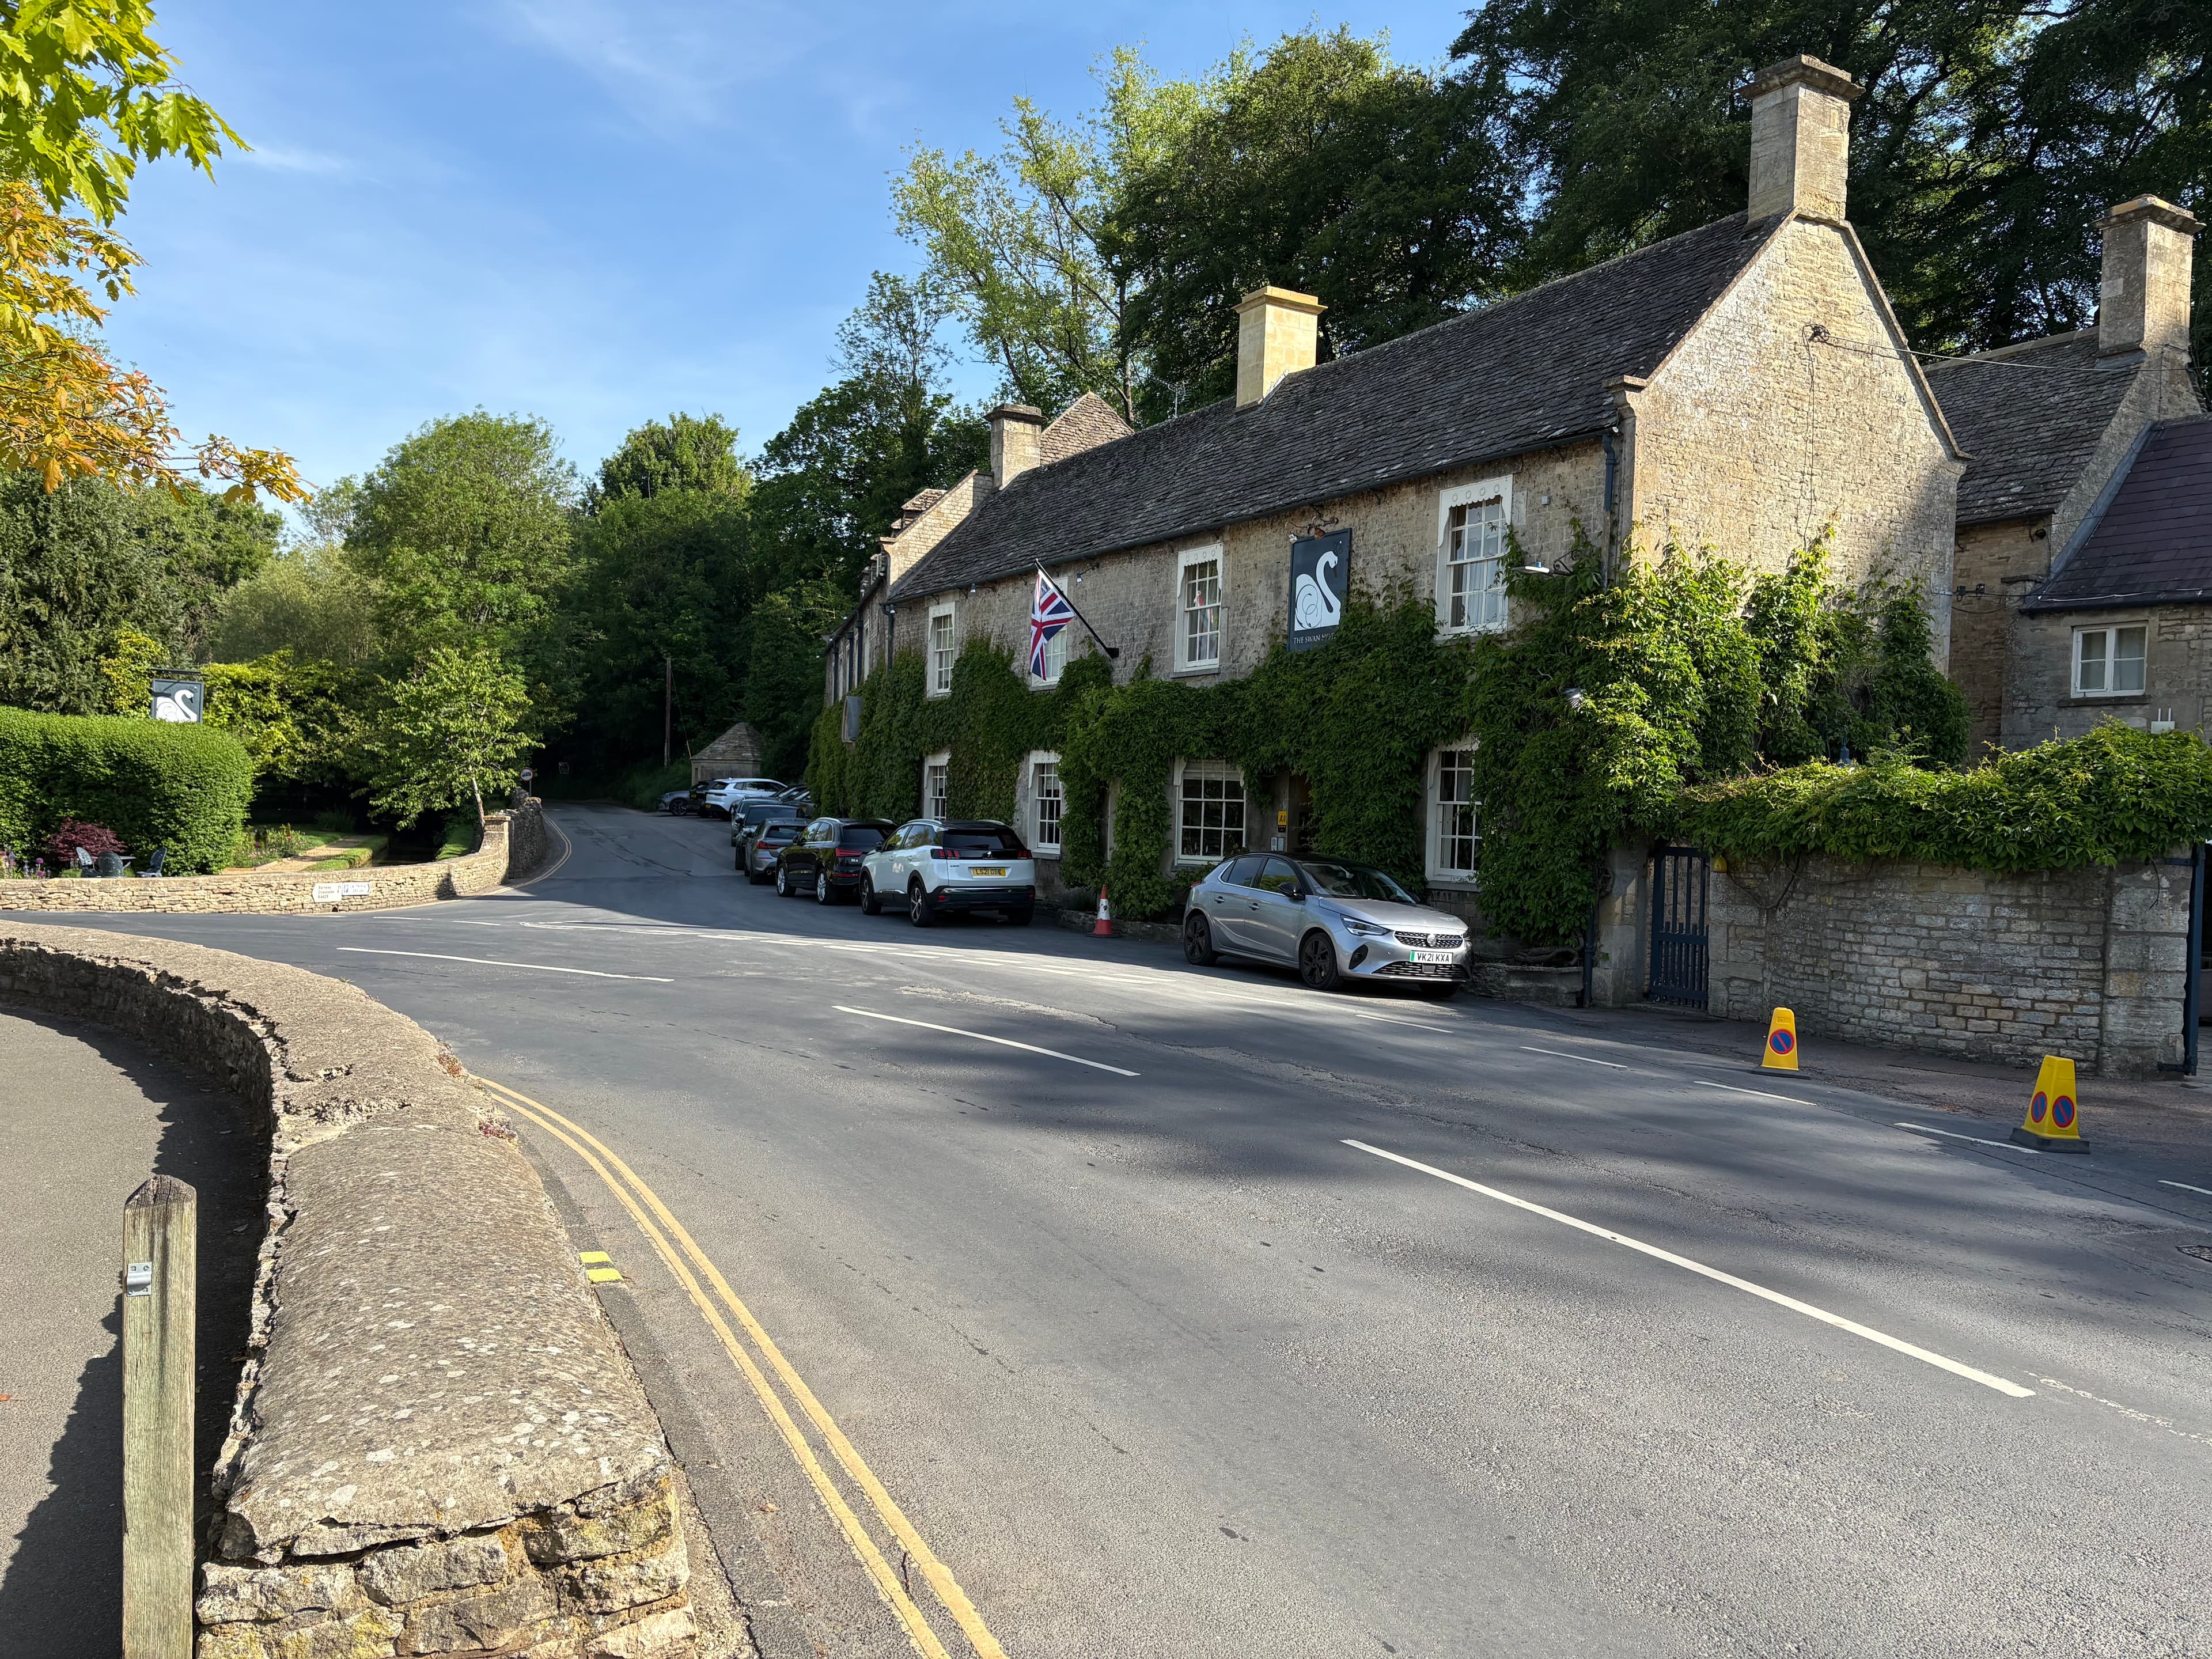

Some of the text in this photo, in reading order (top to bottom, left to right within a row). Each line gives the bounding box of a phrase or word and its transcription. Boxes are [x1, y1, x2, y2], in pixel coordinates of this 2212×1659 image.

[1293, 637, 1304, 645] THE
[1305, 634, 1320, 643] SWAN
[1417, 953, 1449, 962] VK21 KXA
